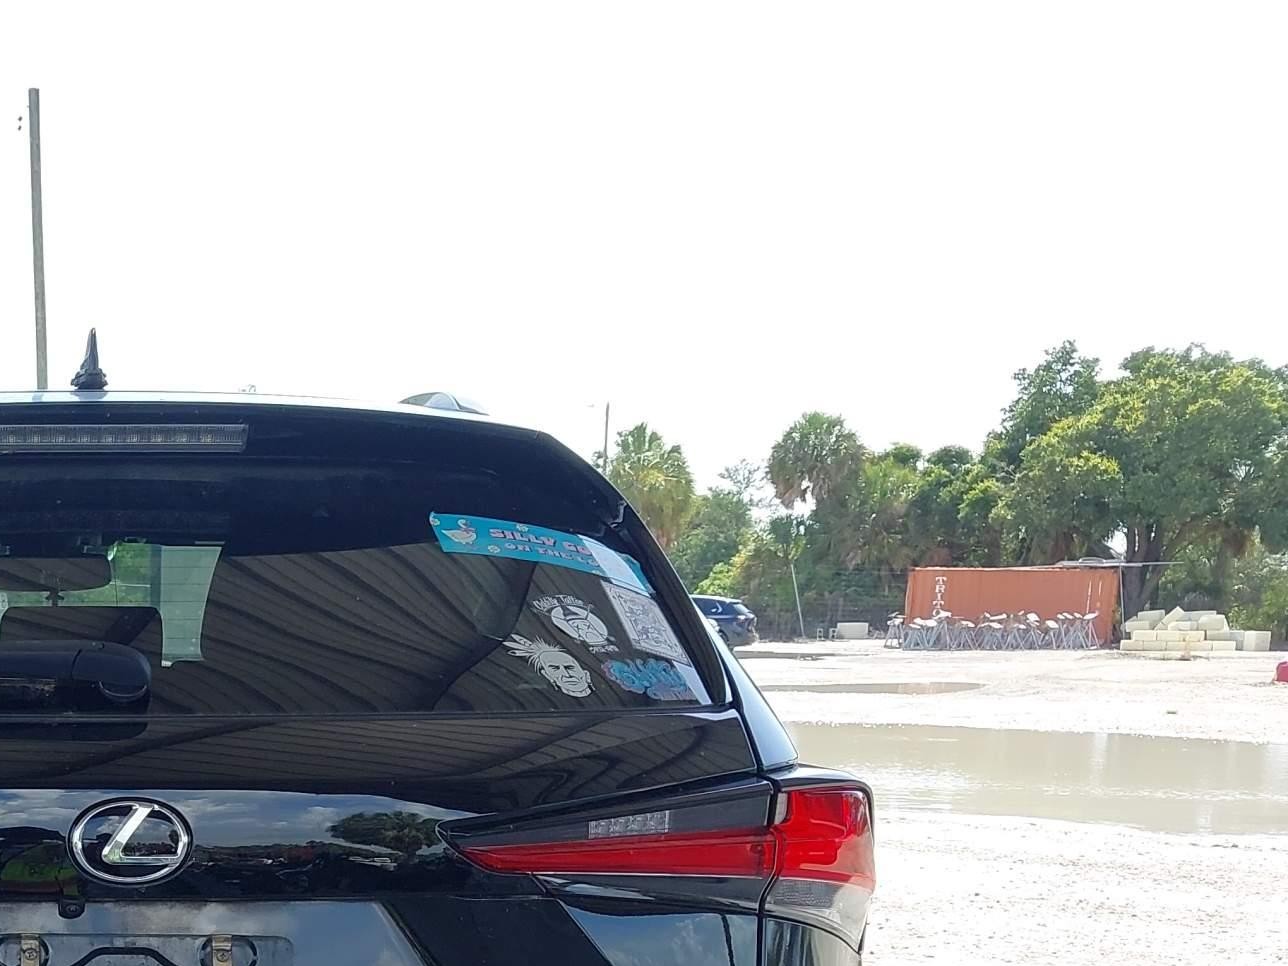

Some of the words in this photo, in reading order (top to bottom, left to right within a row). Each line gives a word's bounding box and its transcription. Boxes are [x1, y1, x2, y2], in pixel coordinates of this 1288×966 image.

[489, 528, 556, 547] SILLY
[564, 541, 593, 557] GO
[932, 576, 947, 618] TRITO
